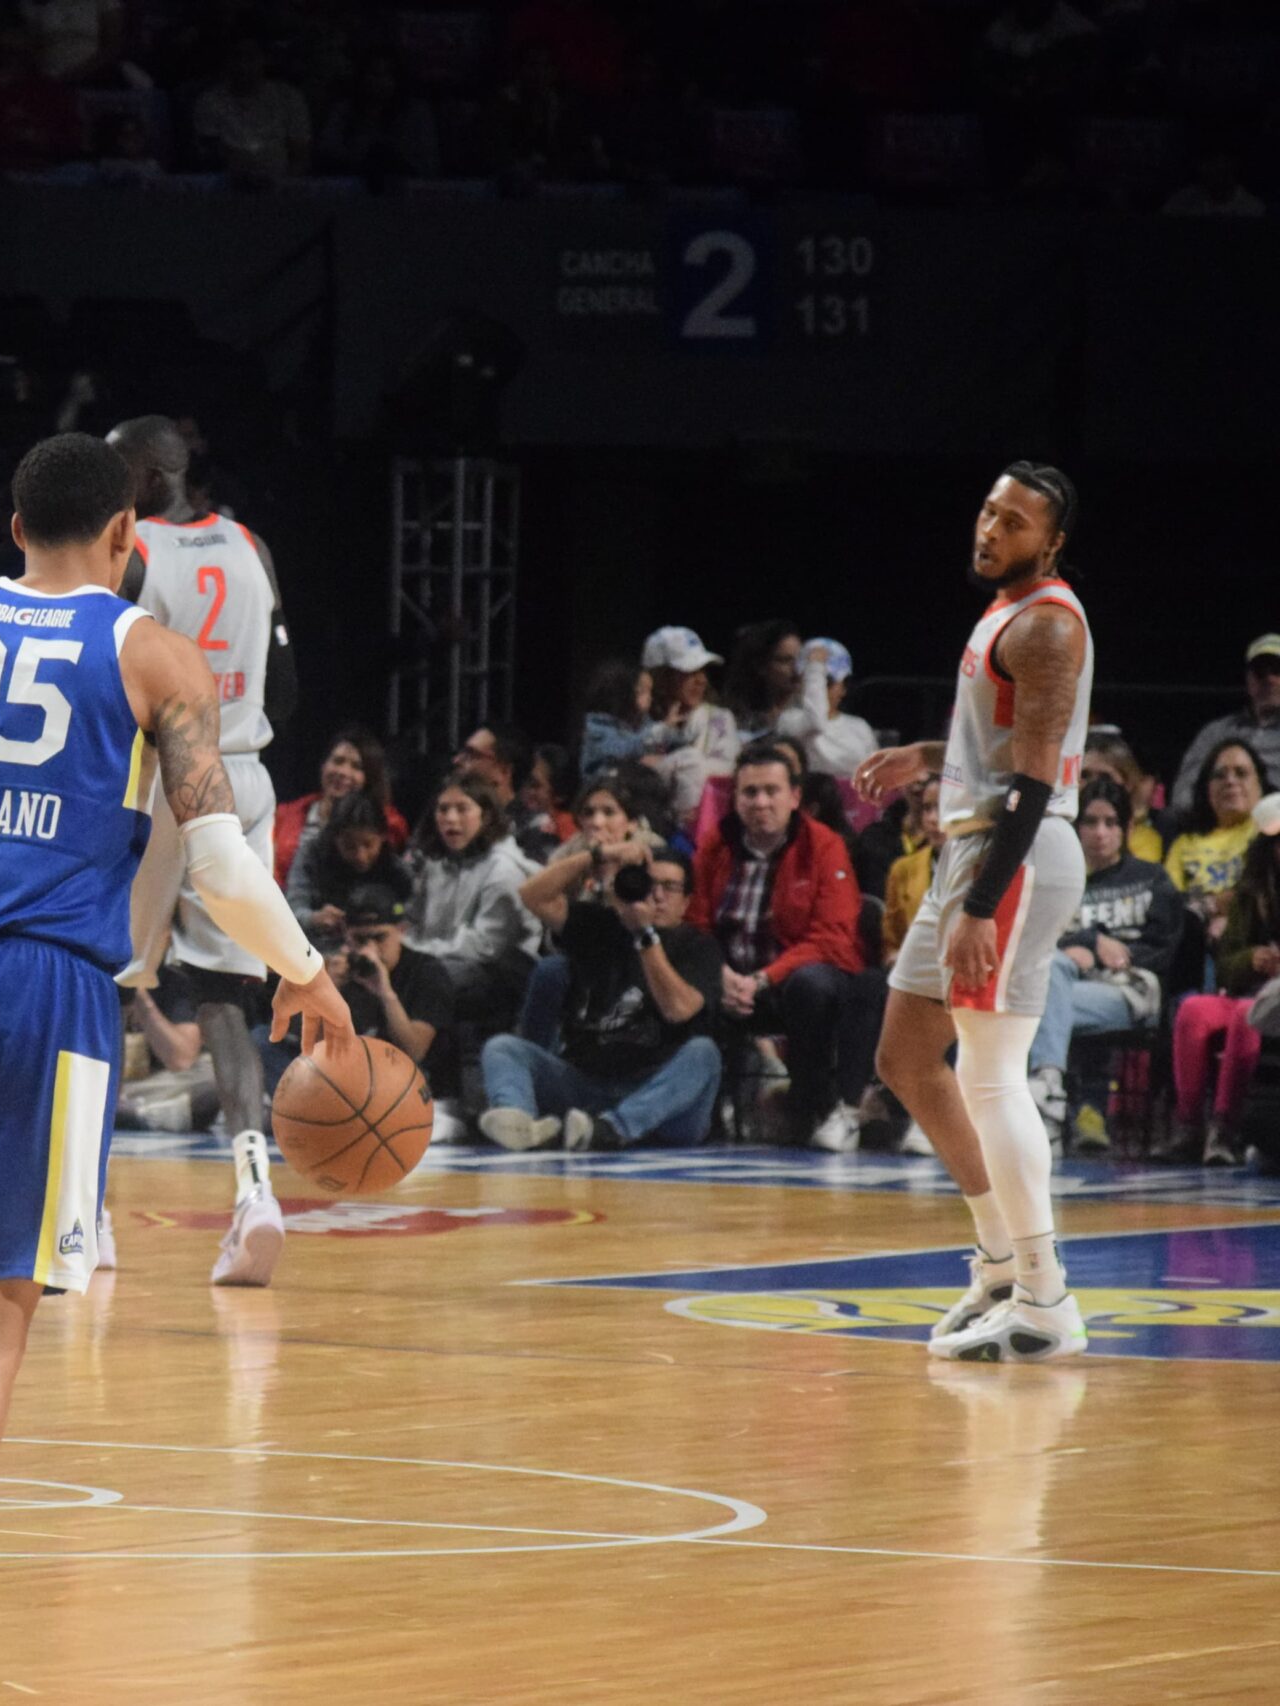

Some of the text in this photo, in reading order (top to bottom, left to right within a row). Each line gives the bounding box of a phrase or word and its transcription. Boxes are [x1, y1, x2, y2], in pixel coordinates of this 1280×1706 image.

[560, 249, 656, 277] CANCHA
[795, 235, 875, 275] 130
[558, 286, 660, 314] GENERAL
[680, 229, 757, 338] 2
[795, 294, 869, 335] 131
[196, 566, 229, 650] 2
